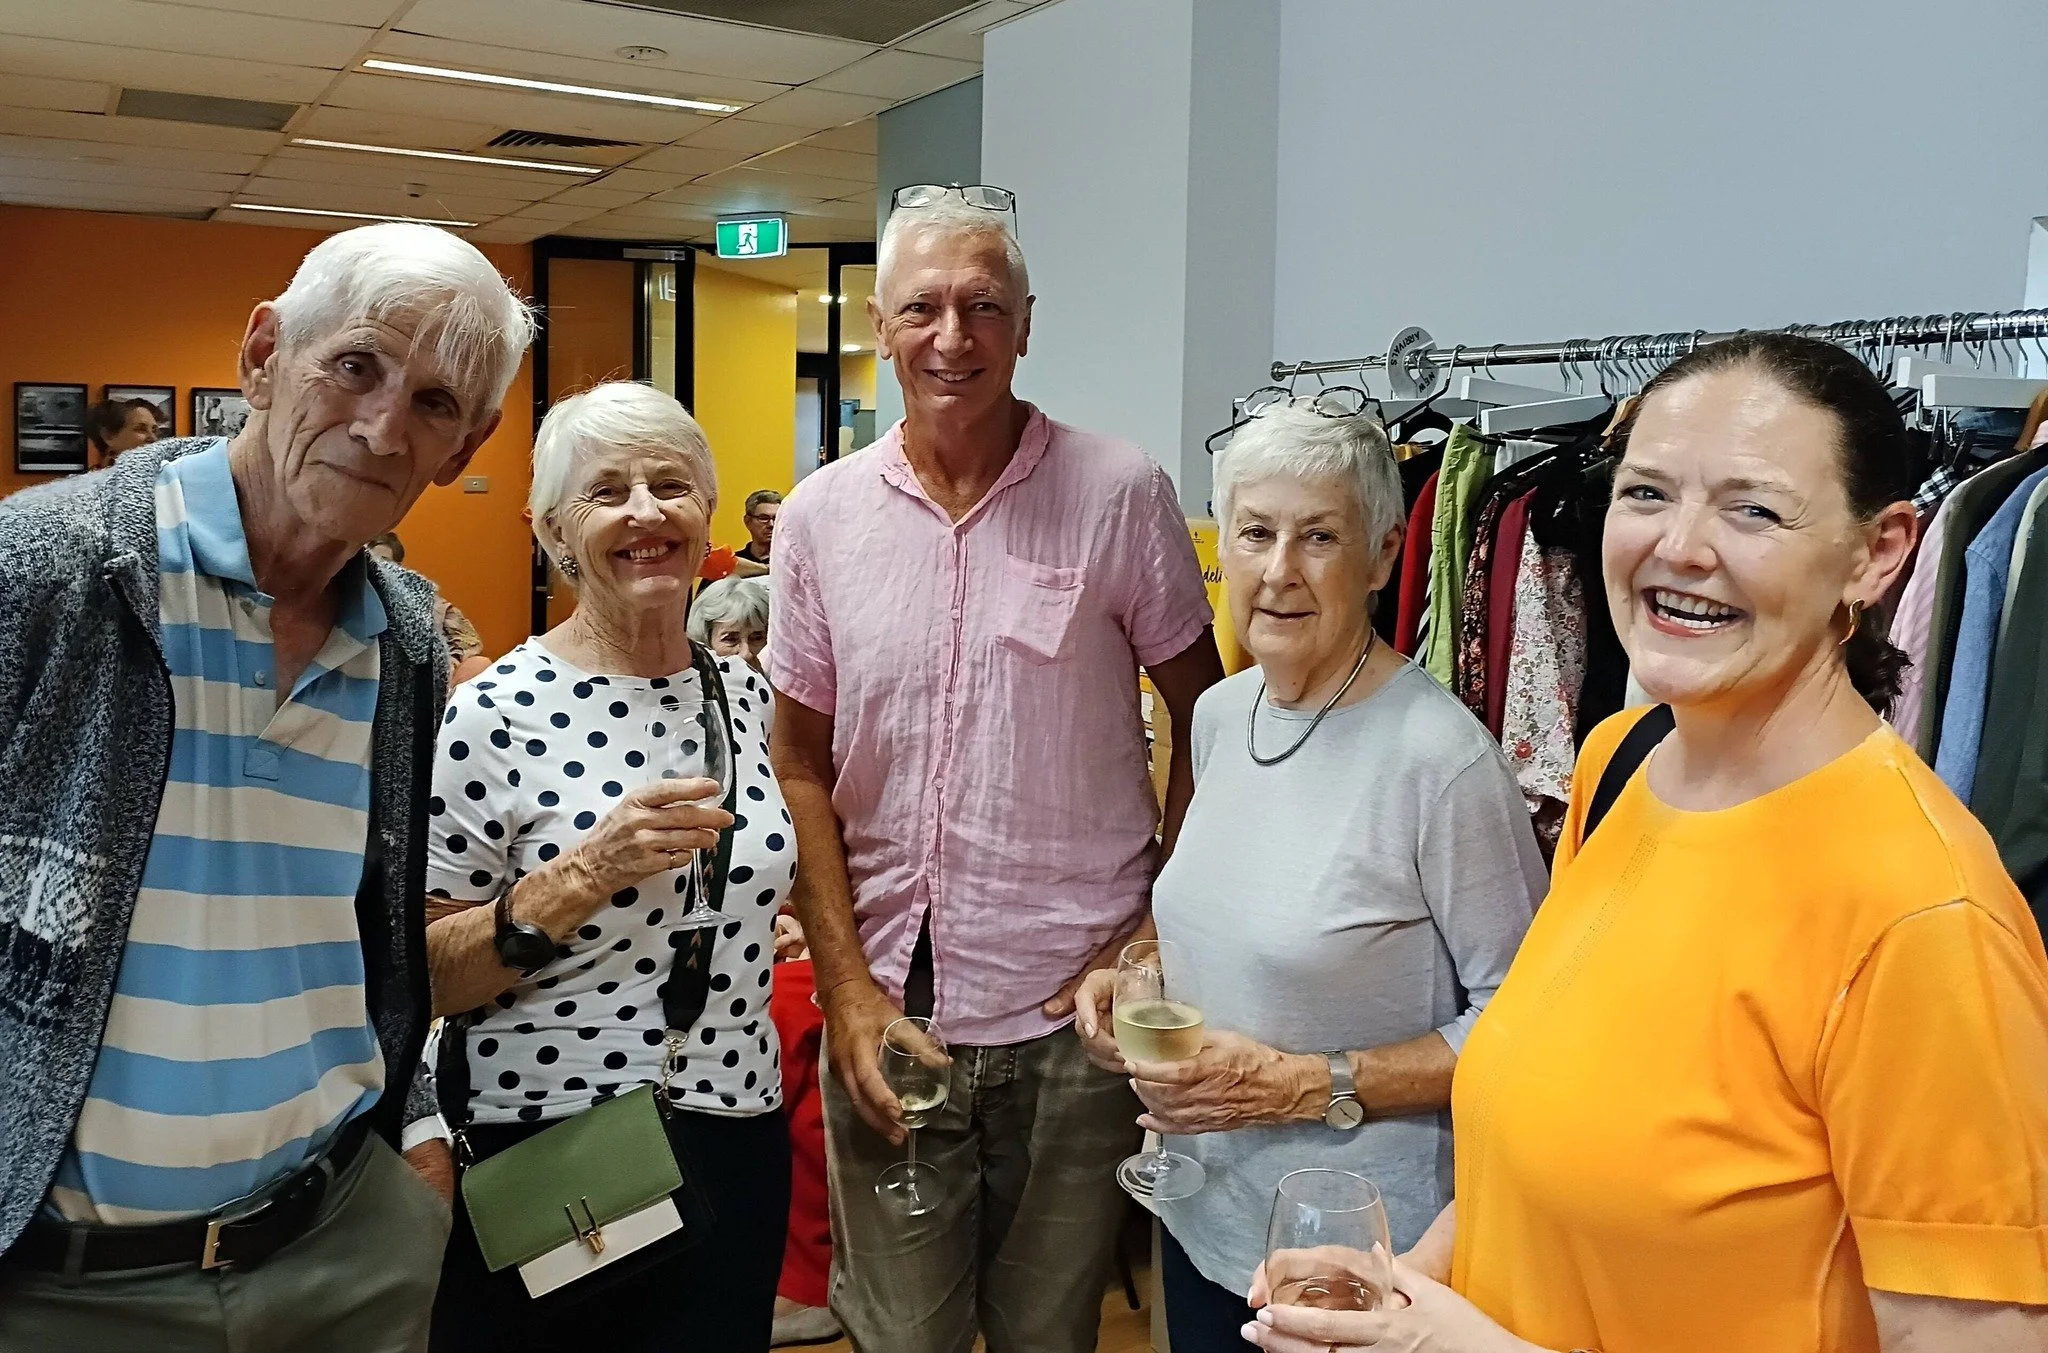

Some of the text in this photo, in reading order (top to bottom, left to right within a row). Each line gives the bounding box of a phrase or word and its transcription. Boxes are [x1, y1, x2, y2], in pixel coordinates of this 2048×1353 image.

[1391, 331, 1420, 365] ARRIVALS
[1419, 372, 1436, 393] NEW
[1203, 565, 1225, 583] deli
